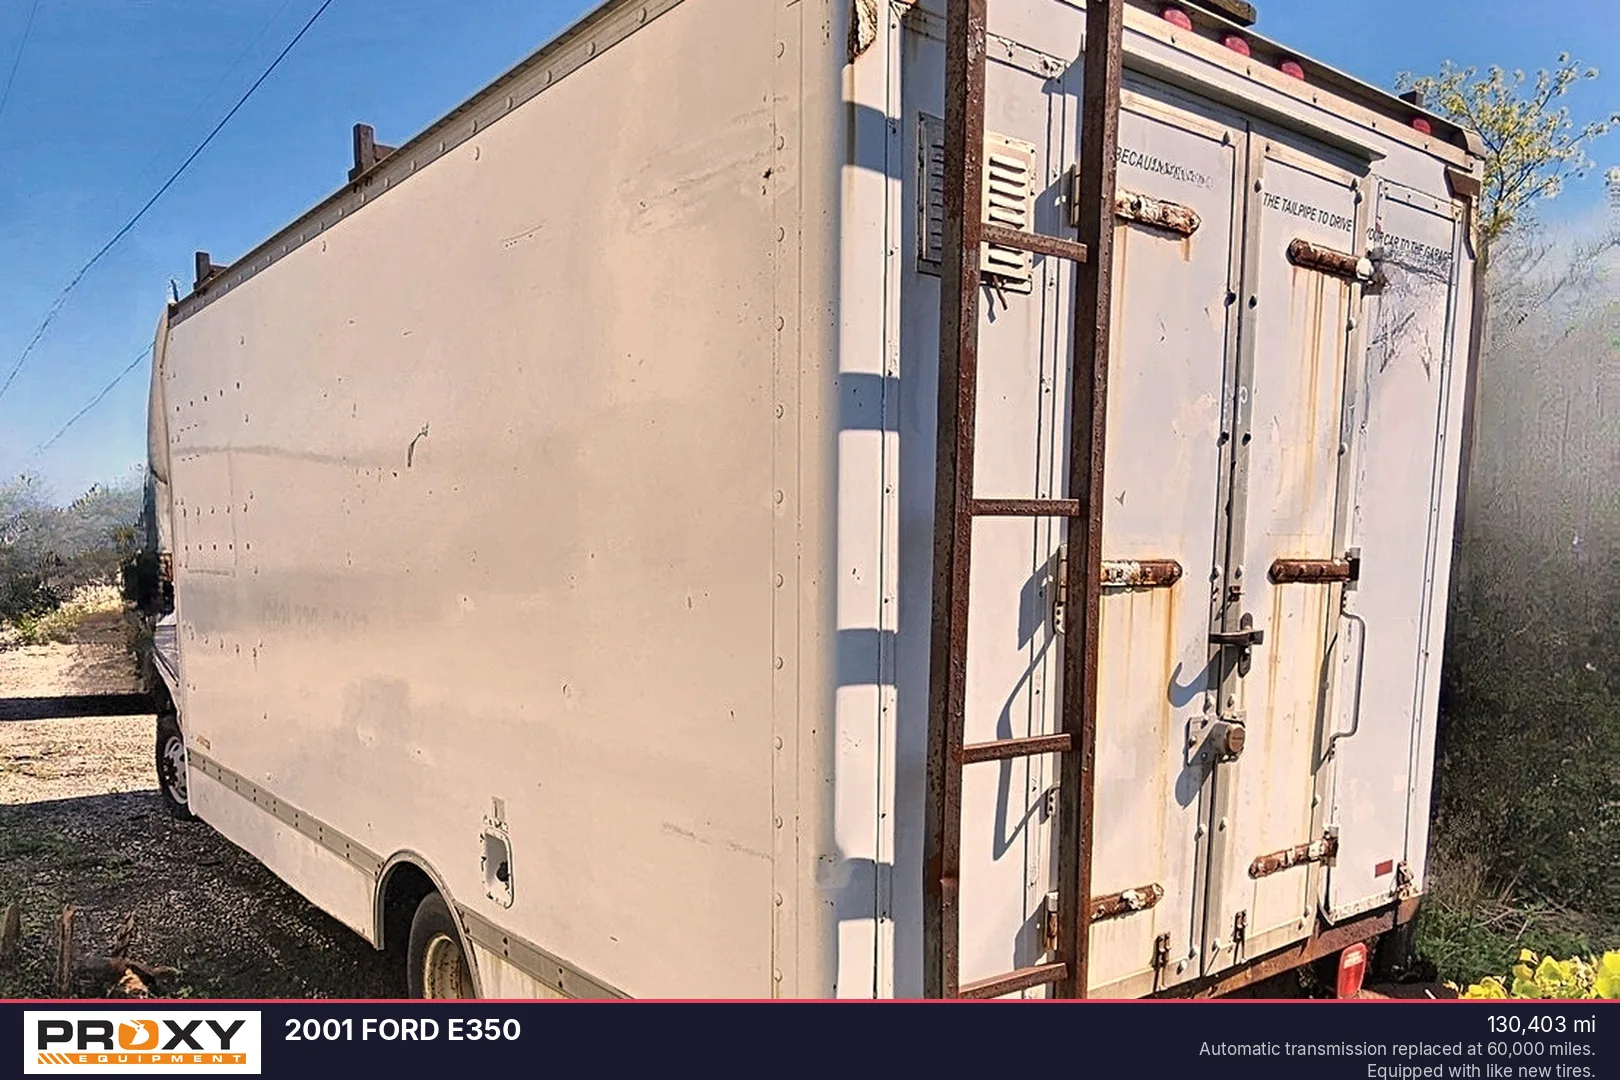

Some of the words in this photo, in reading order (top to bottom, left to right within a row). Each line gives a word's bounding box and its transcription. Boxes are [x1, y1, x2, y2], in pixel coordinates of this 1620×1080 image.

[1263, 192, 1281, 210] THE
[1281, 198, 1318, 222] TAILPIPE
[1318, 210, 1329, 225] TO
[1329, 214, 1353, 232] DRIVE
[1384, 233, 1400, 249] CAR
